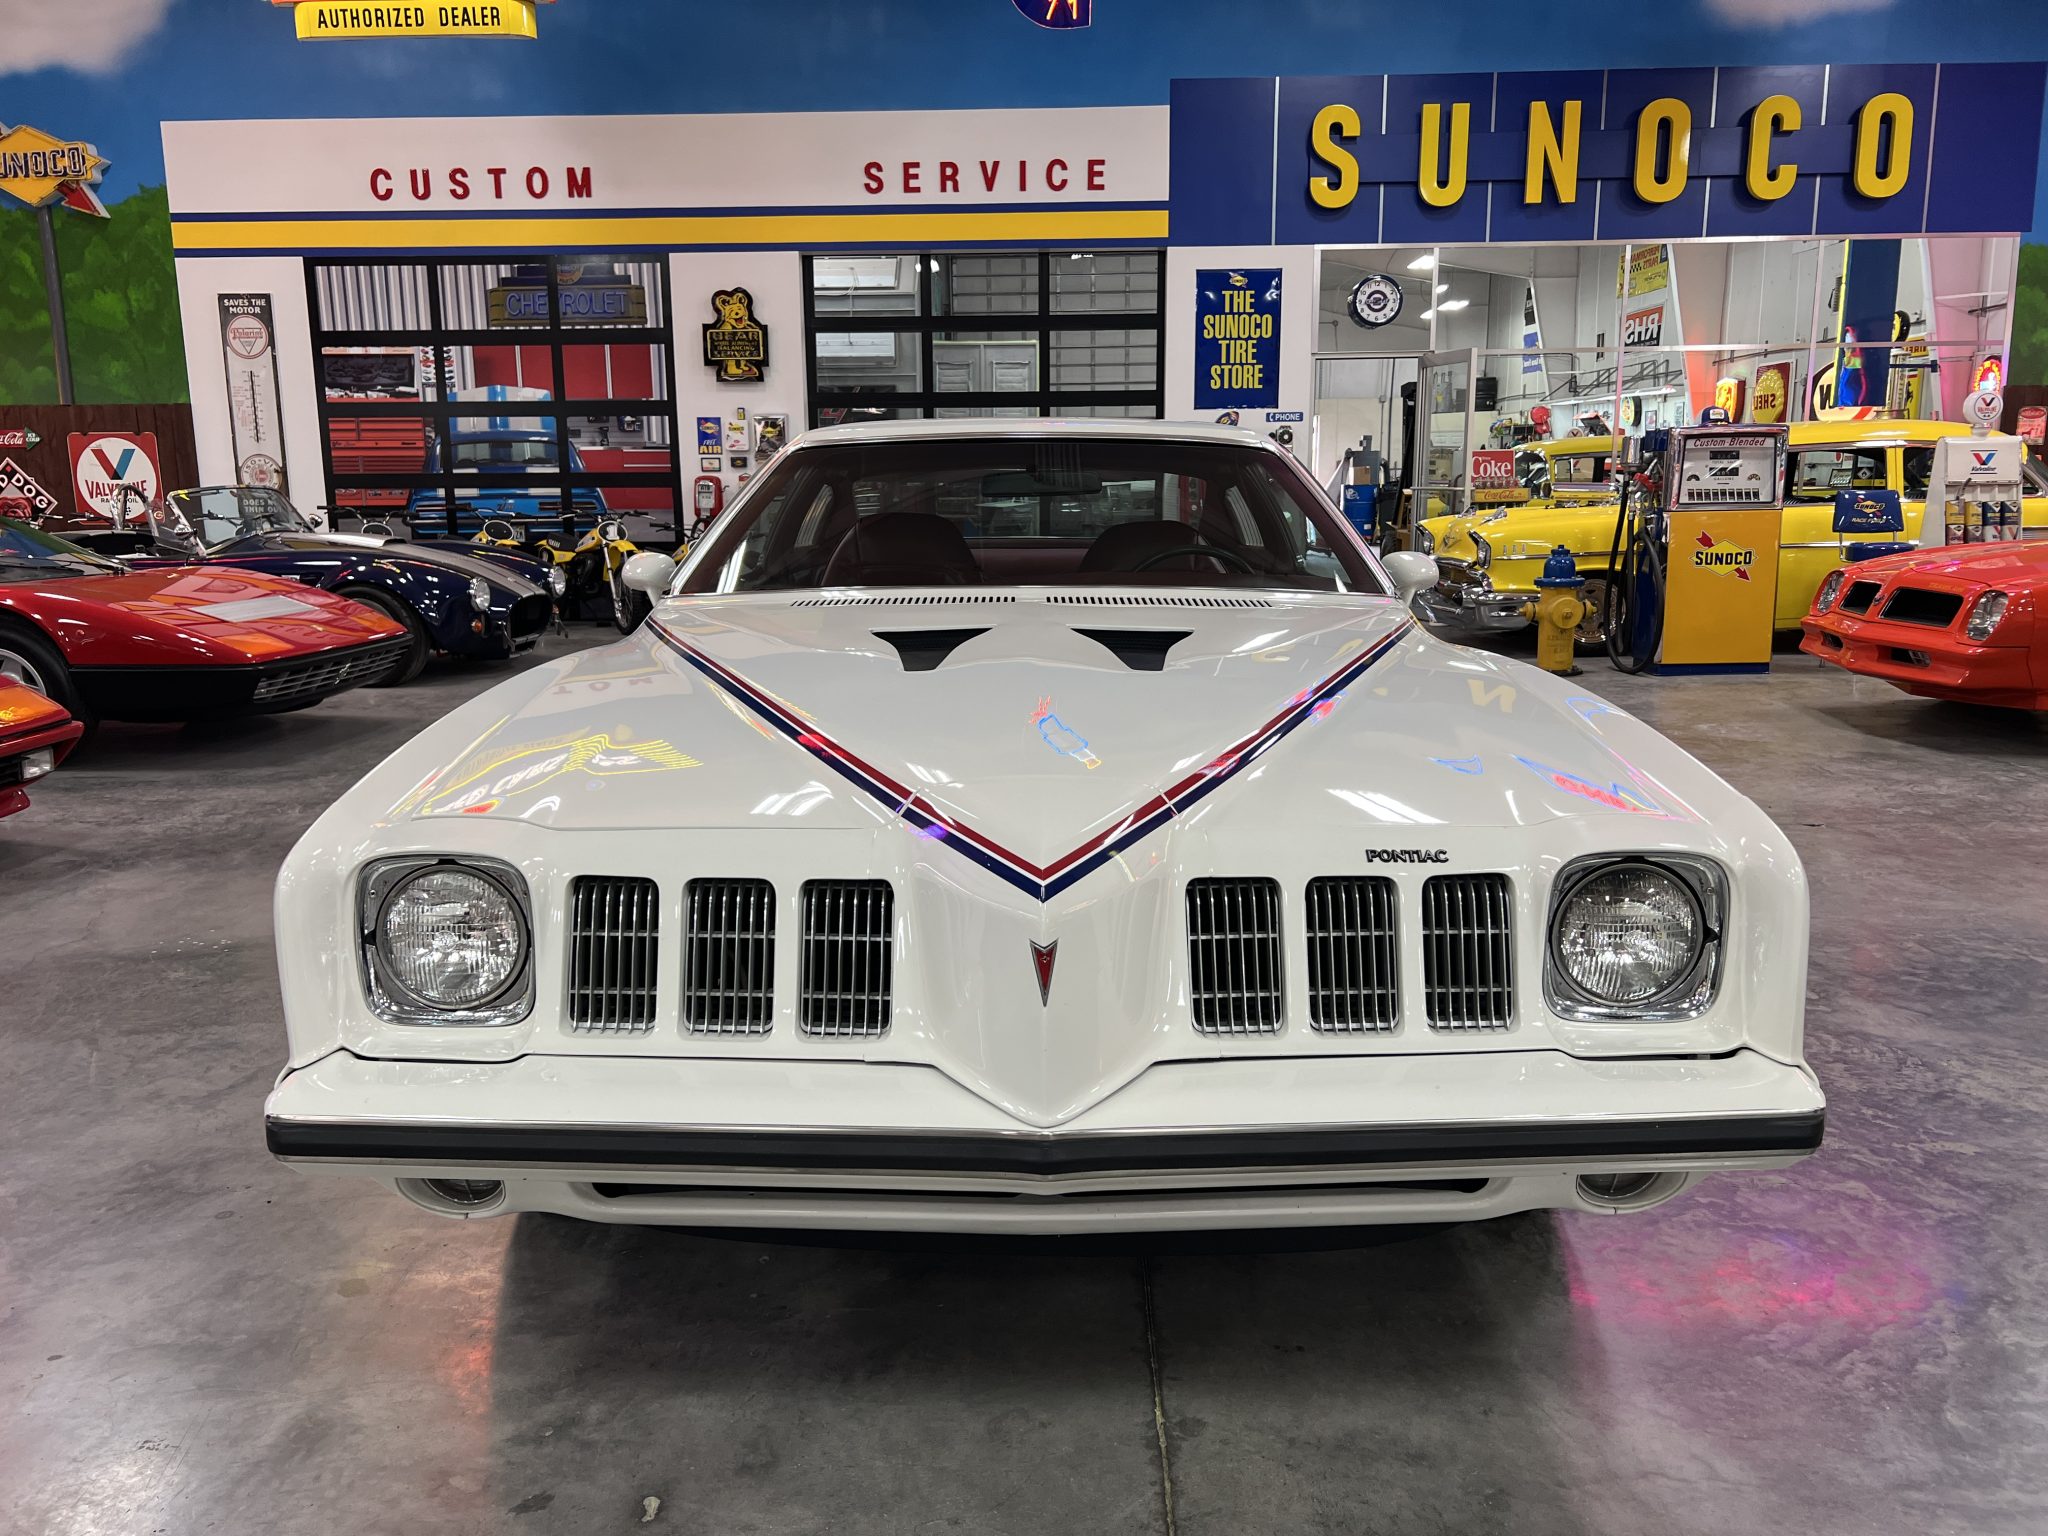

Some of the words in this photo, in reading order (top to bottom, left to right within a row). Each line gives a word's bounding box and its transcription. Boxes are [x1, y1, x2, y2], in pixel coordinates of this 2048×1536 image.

[317, 8, 424, 28] AUTHORIZED
[440, 6, 501, 27] DEALER
[1309, 93, 1914, 209] SUNOCO
[370, 166, 593, 201] CUSTOM
[863, 158, 1106, 194] SERVICE
[223, 298, 249, 306] SAVES
[250, 298, 266, 306] THE
[506, 292, 627, 315] CHEROLET
[1222, 290, 1255, 313] THE
[1203, 314, 1273, 339] SUNOCO
[1218, 340, 1258, 364] TIRE
[1210, 365, 1263, 389] STORE
[1275, 413, 1300, 421] PHONE
[699, 445, 722, 454] AIR
[1471, 456, 1511, 478] Coke
[11, 472, 49, 508] DOG
[242, 498, 265, 506] DOES
[1855, 502, 1885, 510] SUNOCO
[606, 524, 620, 540] 1
[1695, 550, 1752, 566] SUNOCO
[1365, 848, 1449, 863] PONTIAC
